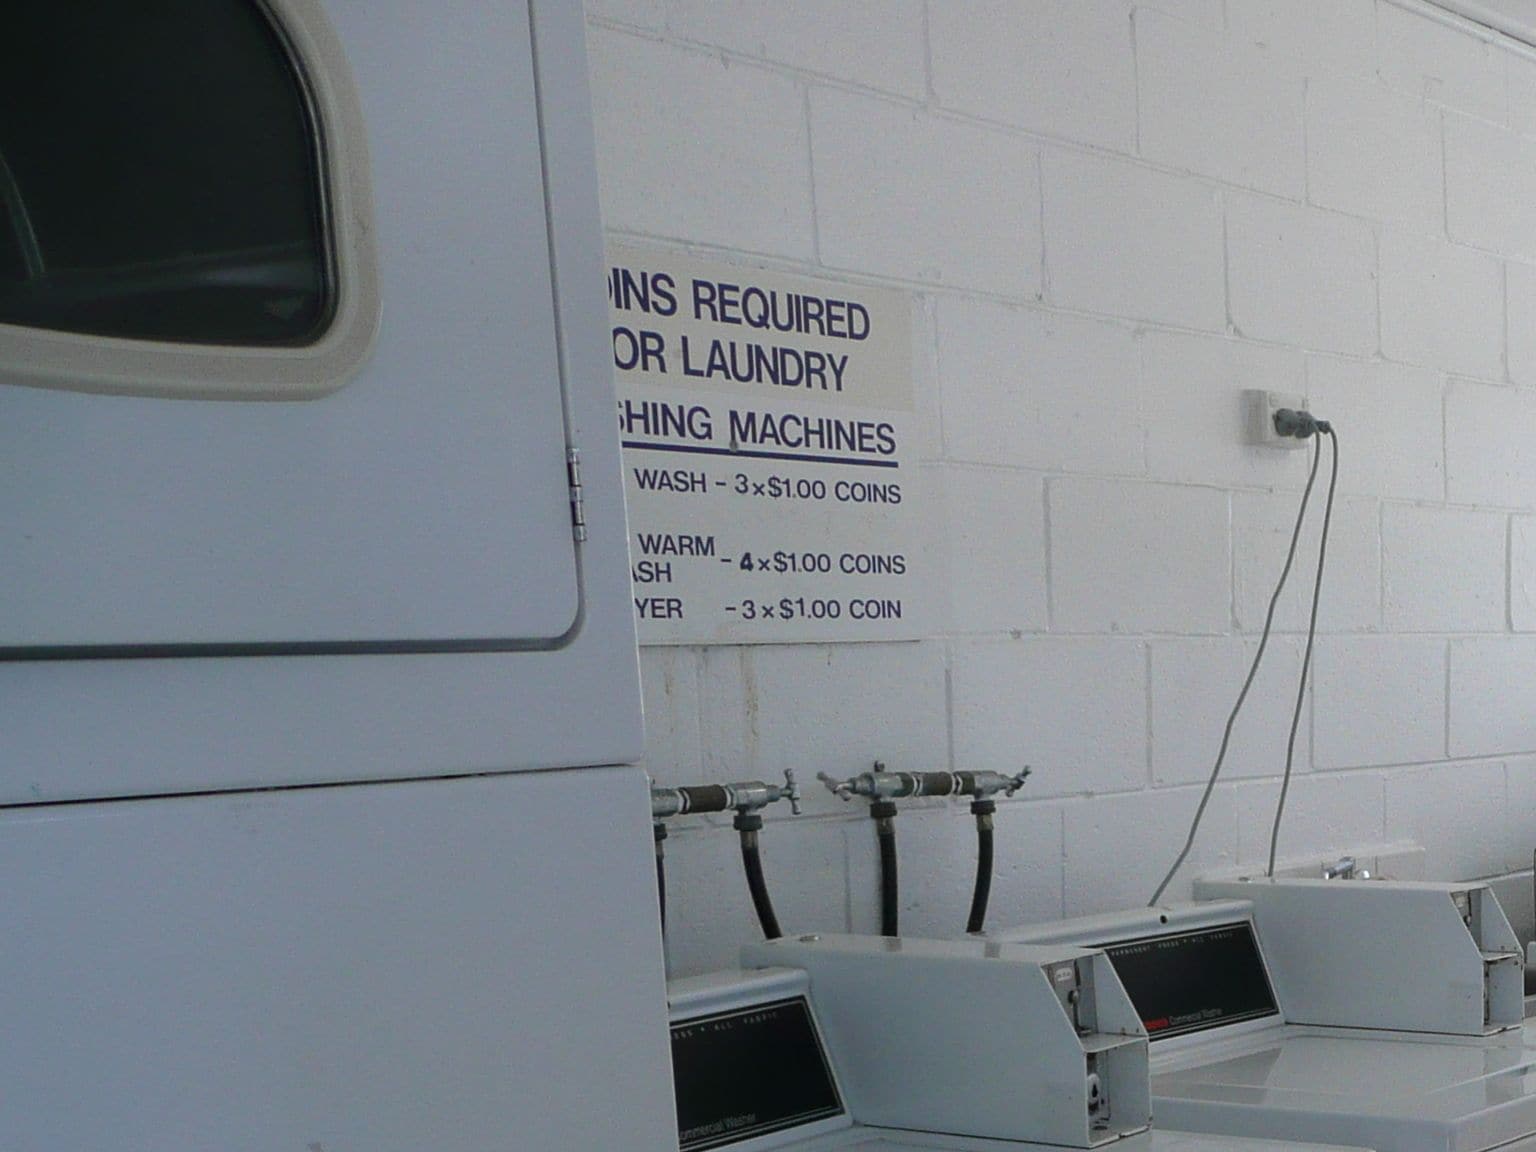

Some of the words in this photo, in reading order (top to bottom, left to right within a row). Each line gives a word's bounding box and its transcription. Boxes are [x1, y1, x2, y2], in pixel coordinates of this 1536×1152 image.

[608, 268, 677, 317] INS
[692, 279, 870, 340] REQUIRED
[681, 335, 849, 392] LAUNDRY
[728, 409, 896, 455] MACHINES
[634, 468, 707, 493] WASH
[835, 480, 901, 504] COINS
[638, 533, 715, 557] WARM
[839, 553, 906, 575] COINS
[849, 599, 901, 619] COIN
